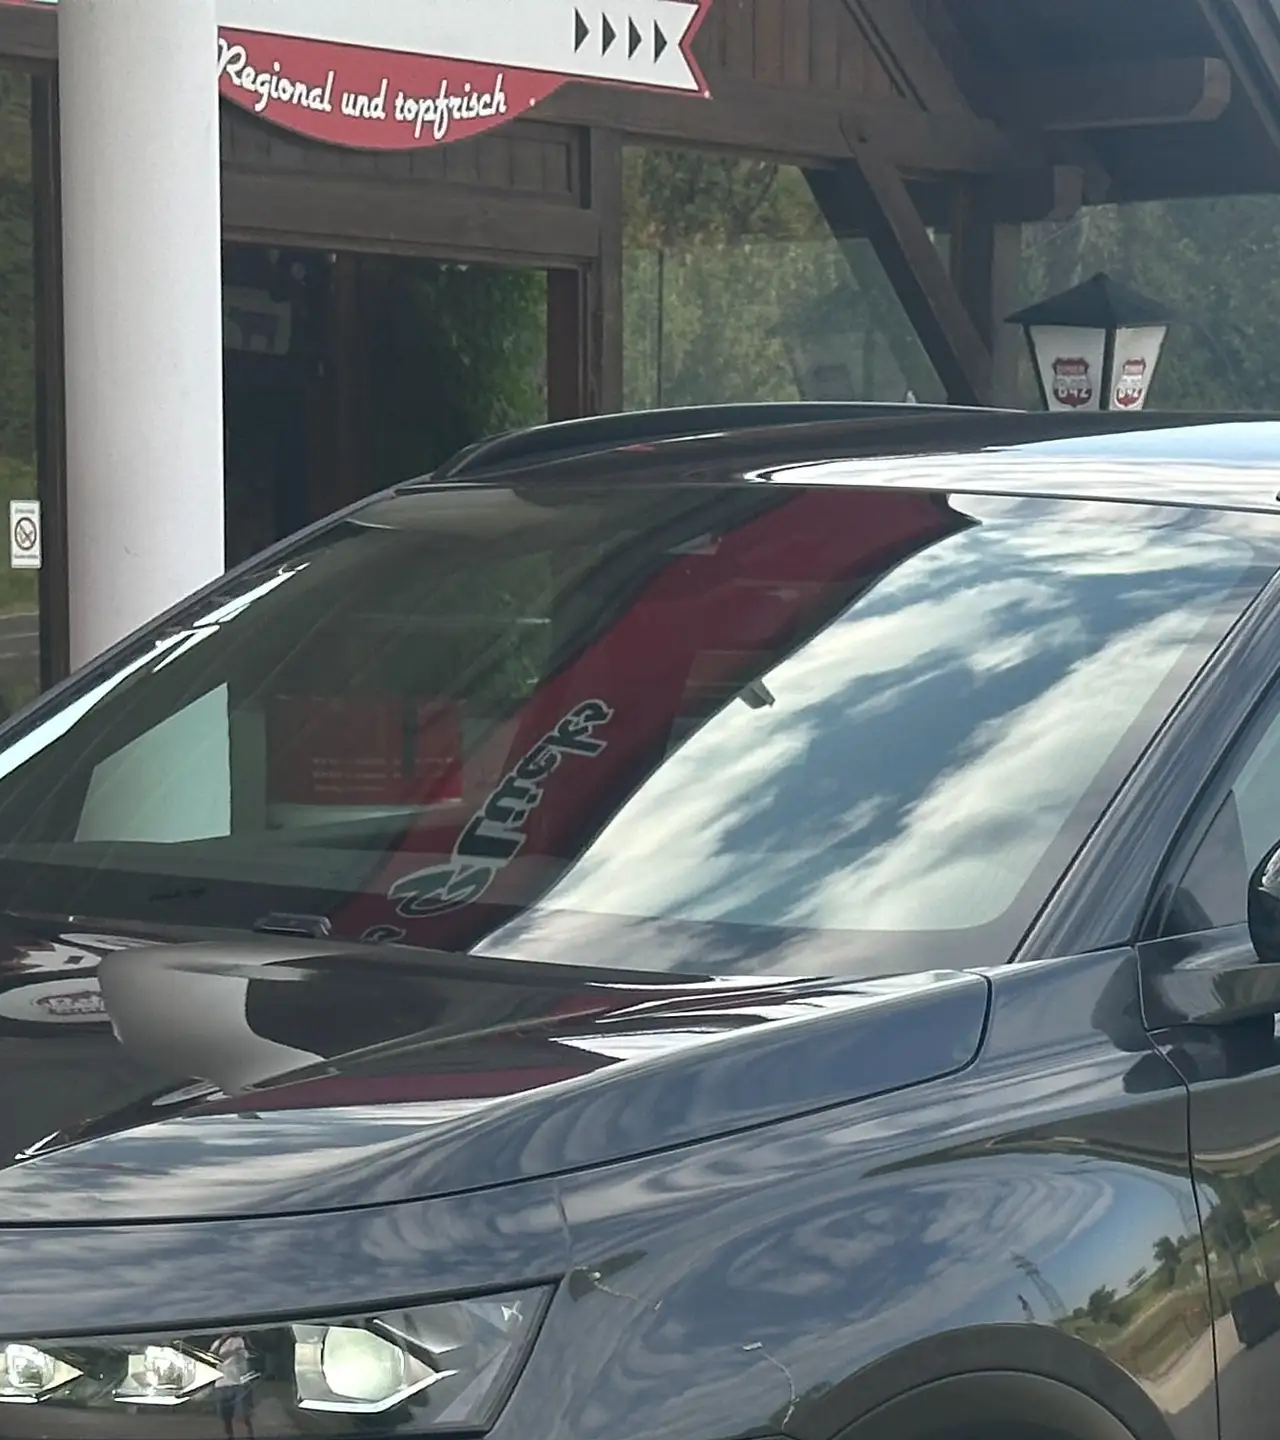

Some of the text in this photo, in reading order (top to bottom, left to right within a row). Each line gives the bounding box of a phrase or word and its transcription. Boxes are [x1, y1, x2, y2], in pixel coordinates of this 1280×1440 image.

[217, 37, 508, 140] Regional und topfrisch
